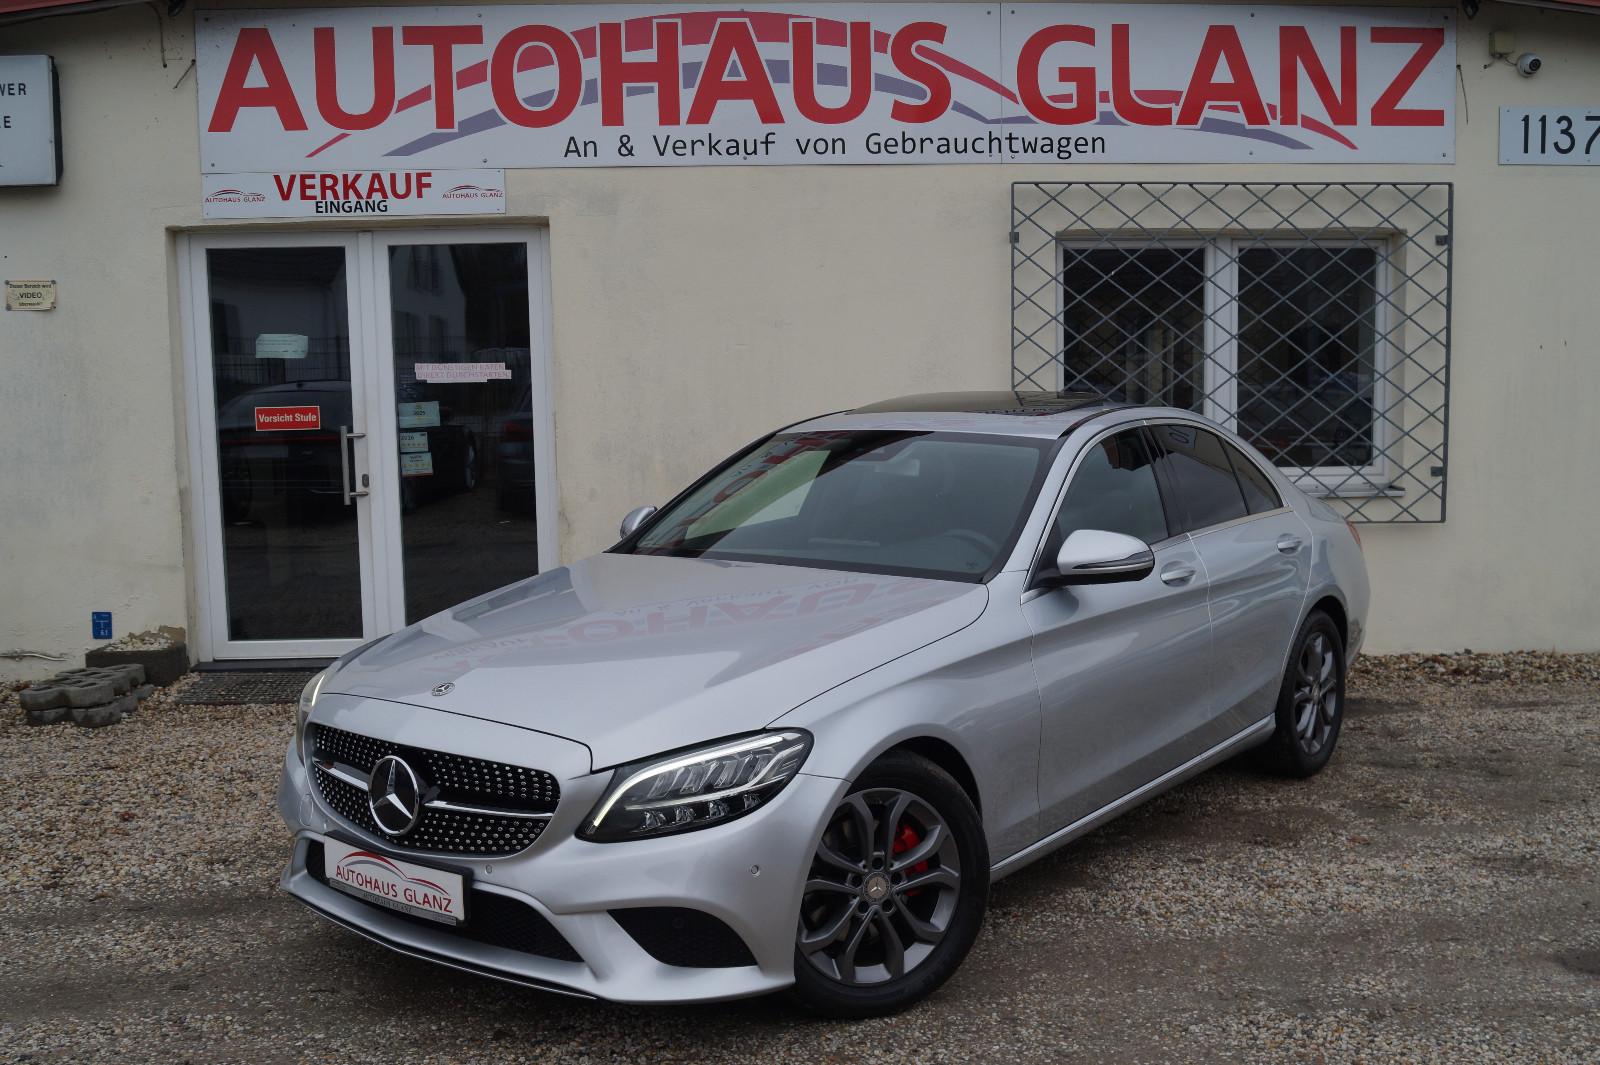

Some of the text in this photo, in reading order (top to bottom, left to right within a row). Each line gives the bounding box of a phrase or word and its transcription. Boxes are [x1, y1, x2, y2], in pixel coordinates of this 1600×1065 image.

[207, 20, 1445, 133] AUTOHAUS GLANZ
[564, 131, 1106, 160] An & Verkauf von Gebrauchtwagen
[273, 172, 432, 201] VERKAUF
[243, 195, 266, 203] GLANZ
[315, 200, 388, 214] EINGANG
[19, 291, 42, 299] VIDEO
[258, 412, 317, 423] Vorsicht Stufe
[336, 865, 453, 914] AUTOHAUS GLANZ
